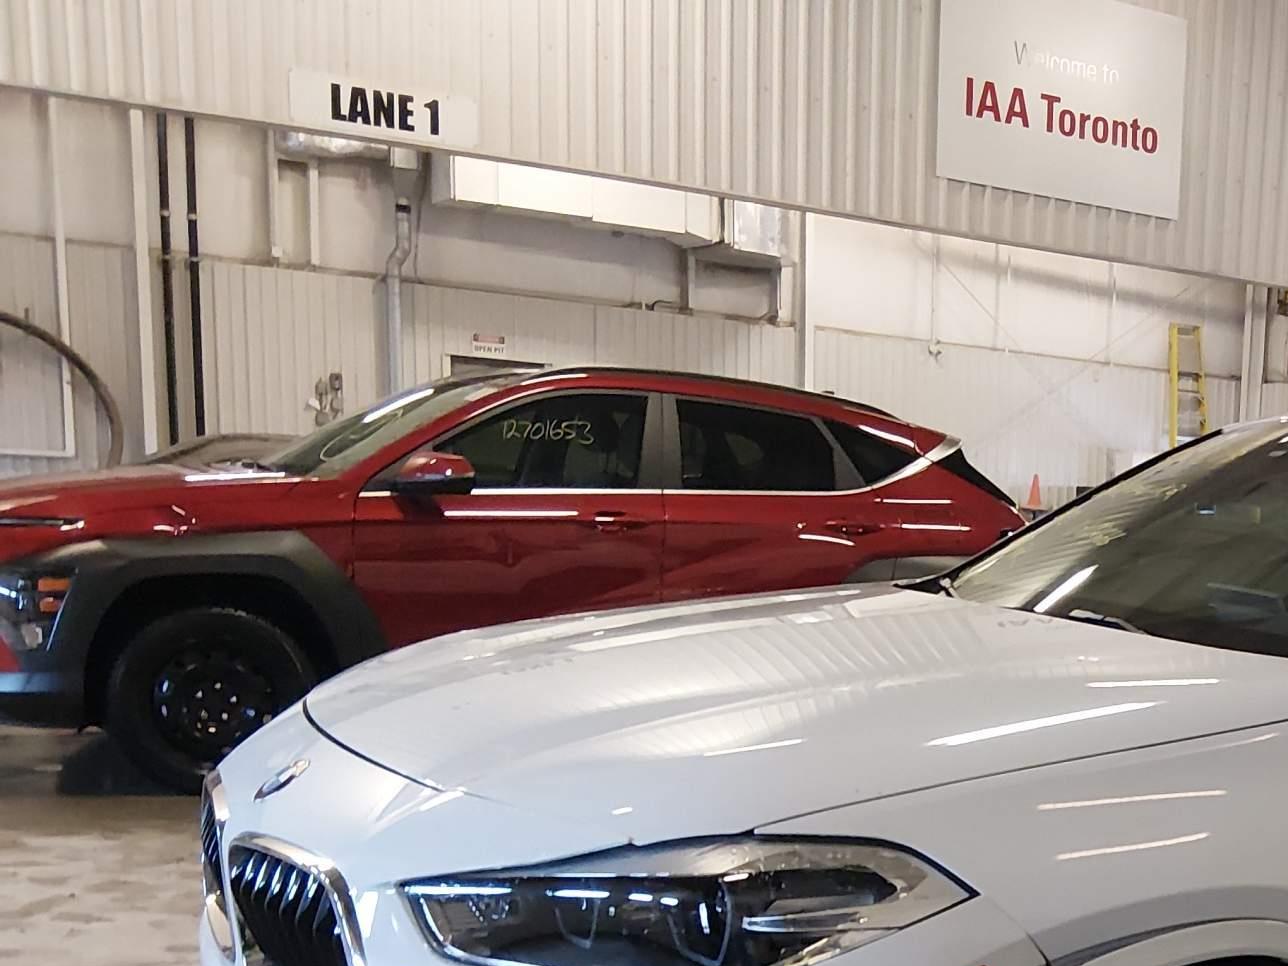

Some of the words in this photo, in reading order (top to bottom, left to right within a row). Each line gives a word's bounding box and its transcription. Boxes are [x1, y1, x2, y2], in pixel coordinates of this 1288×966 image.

[331, 83, 415, 132] LANE
[424, 99, 440, 136] 1
[965, 77, 1029, 128] IAA
[1041, 93, 1158, 154] Toronto
[503, 418, 594, 444] 12701653
